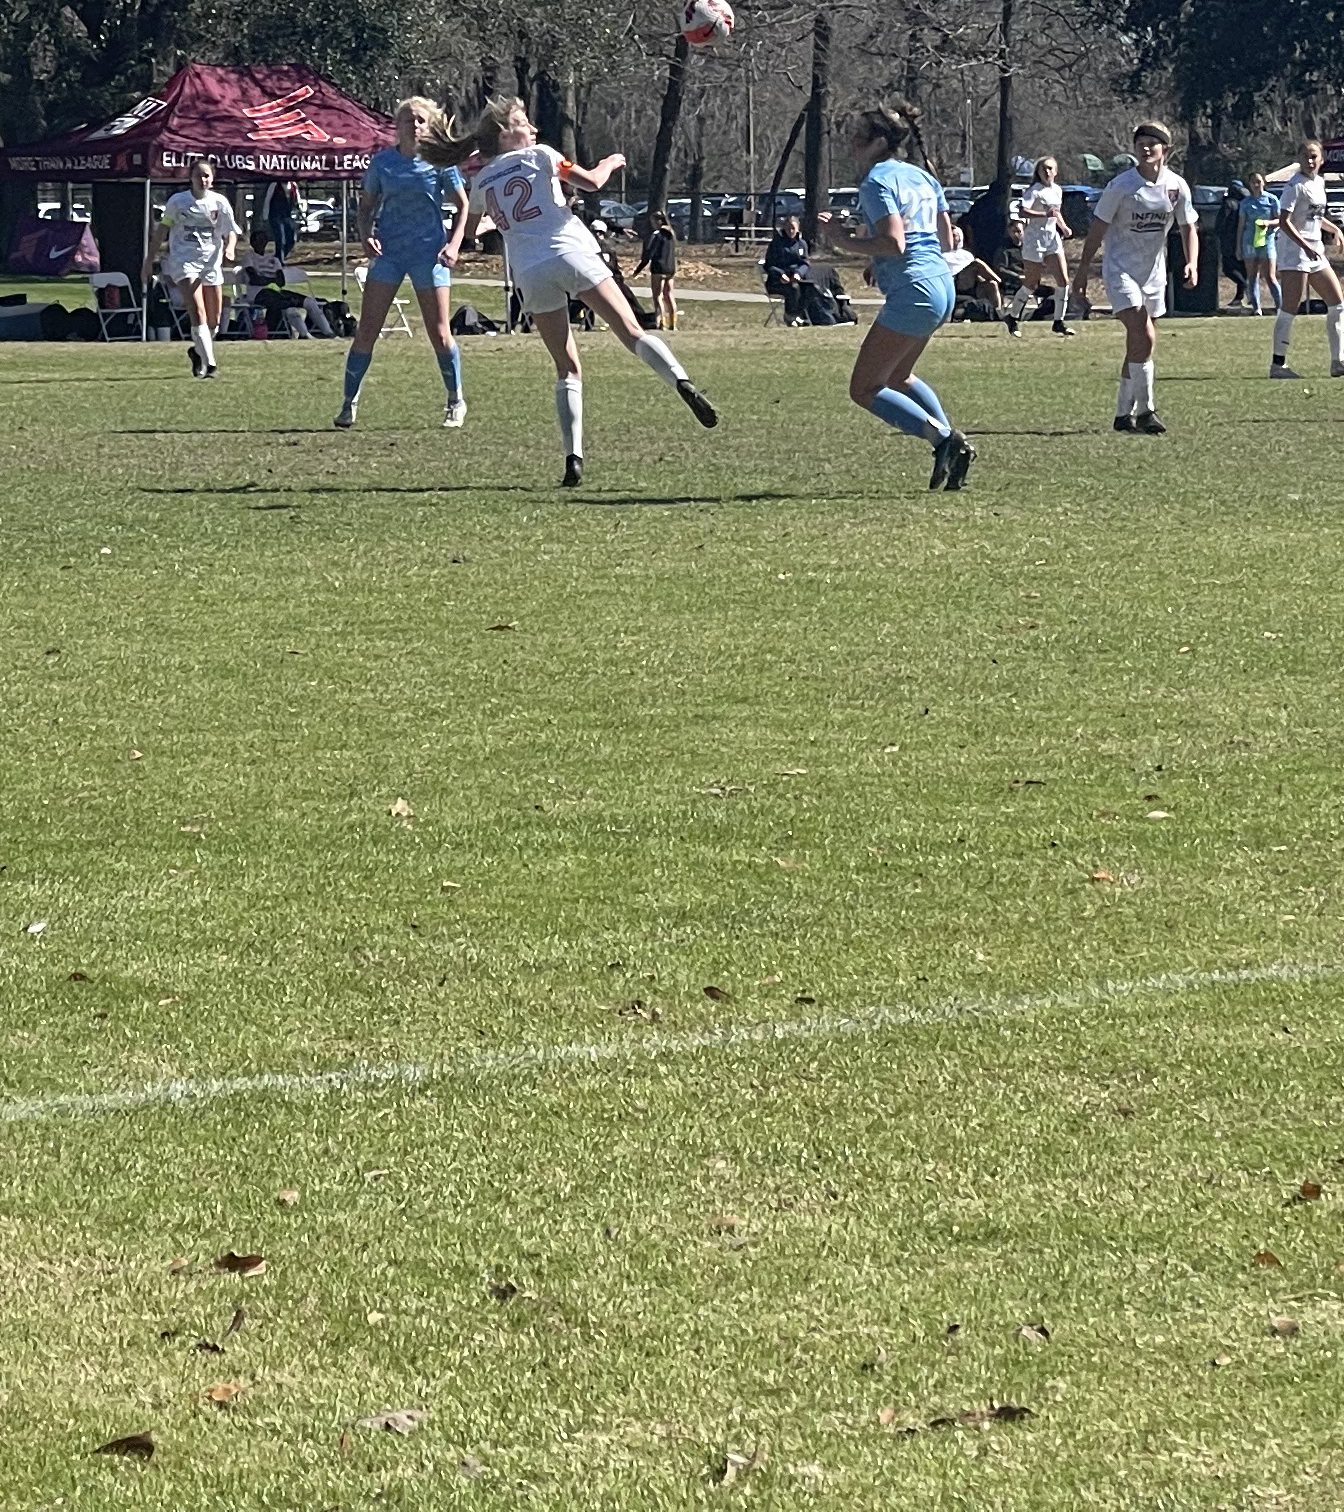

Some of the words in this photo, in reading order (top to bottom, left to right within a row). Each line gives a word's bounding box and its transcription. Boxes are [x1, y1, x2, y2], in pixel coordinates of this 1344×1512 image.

[64, 157, 73, 170] A
[72, 154, 112, 170] LEAGUE
[259, 154, 330, 170] NATIONAL
[334, 154, 372, 170] LEAG
